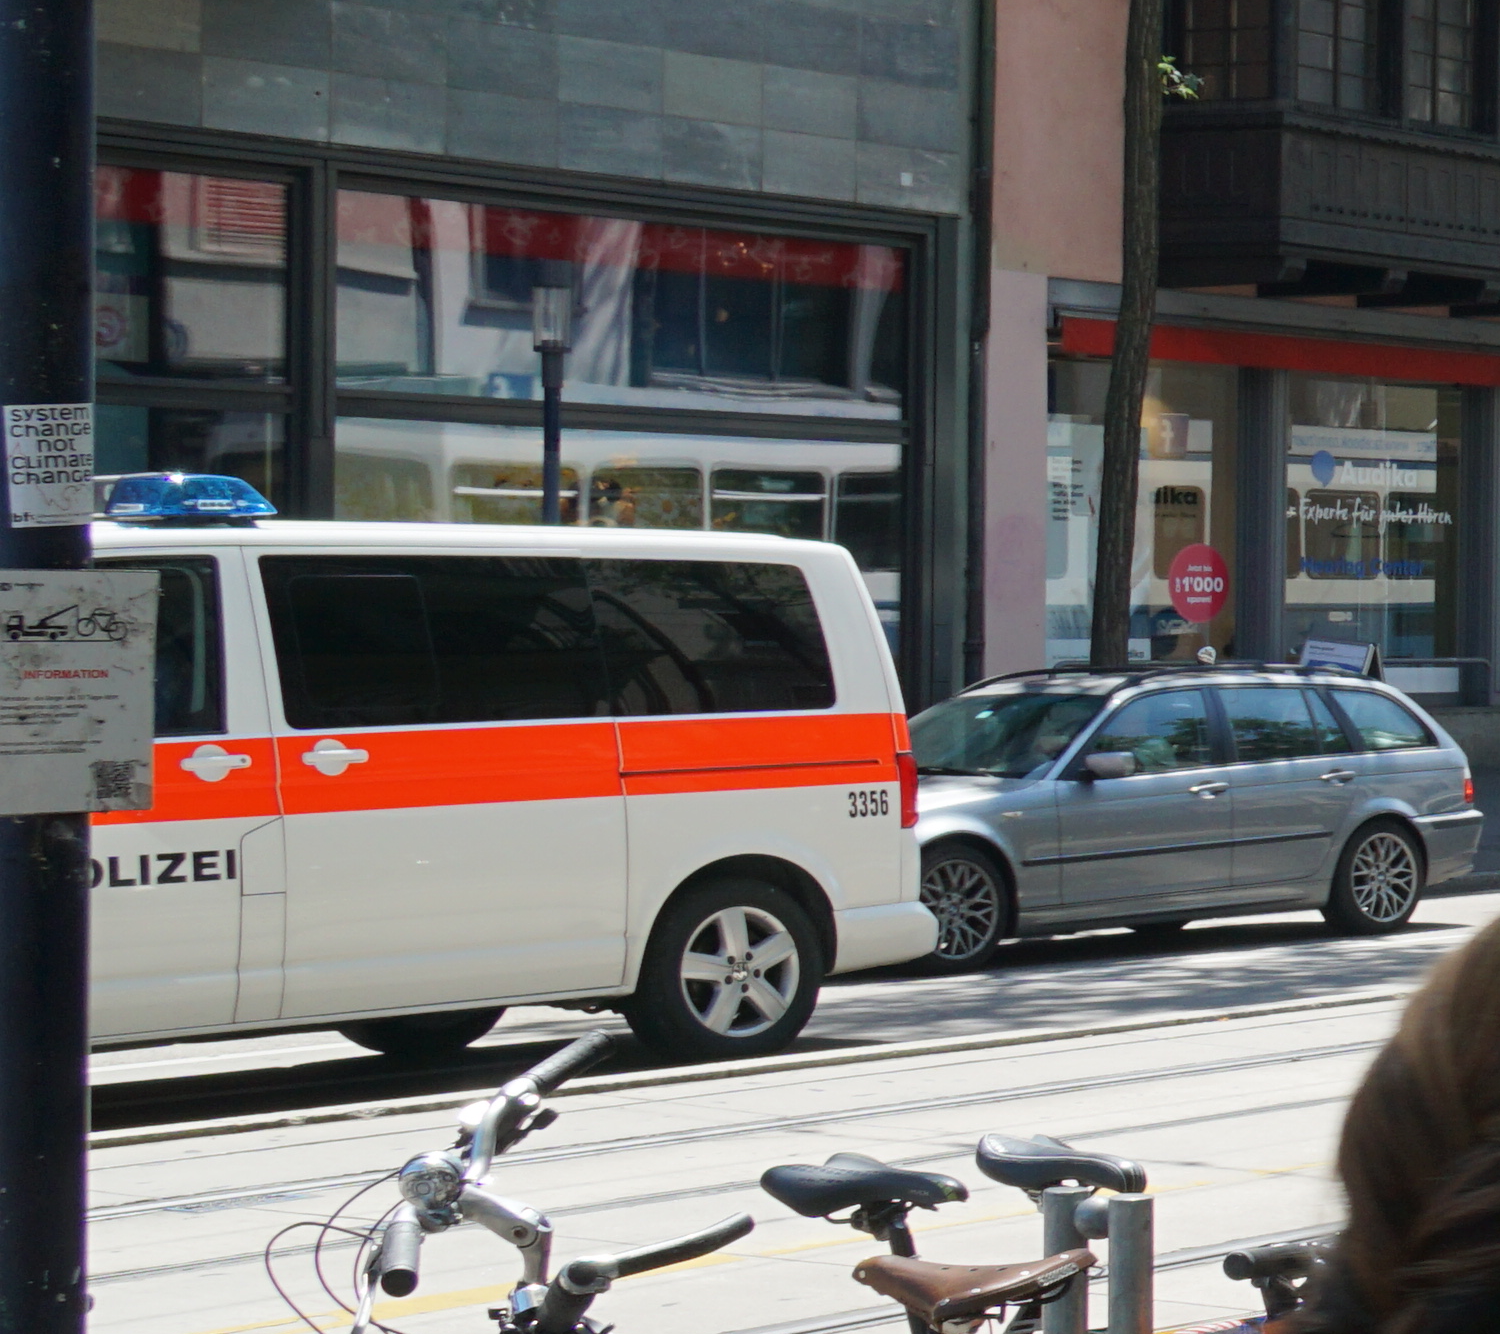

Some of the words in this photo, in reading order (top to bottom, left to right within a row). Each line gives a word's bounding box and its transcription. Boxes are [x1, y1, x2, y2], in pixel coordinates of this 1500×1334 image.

[36, 438, 77, 452] not
[1340, 460, 1418, 488] Audika
[1182, 576, 1224, 594] 1'000
[23, 669, 109, 680] INFORMATION
[848, 788, 890, 819] 3356
